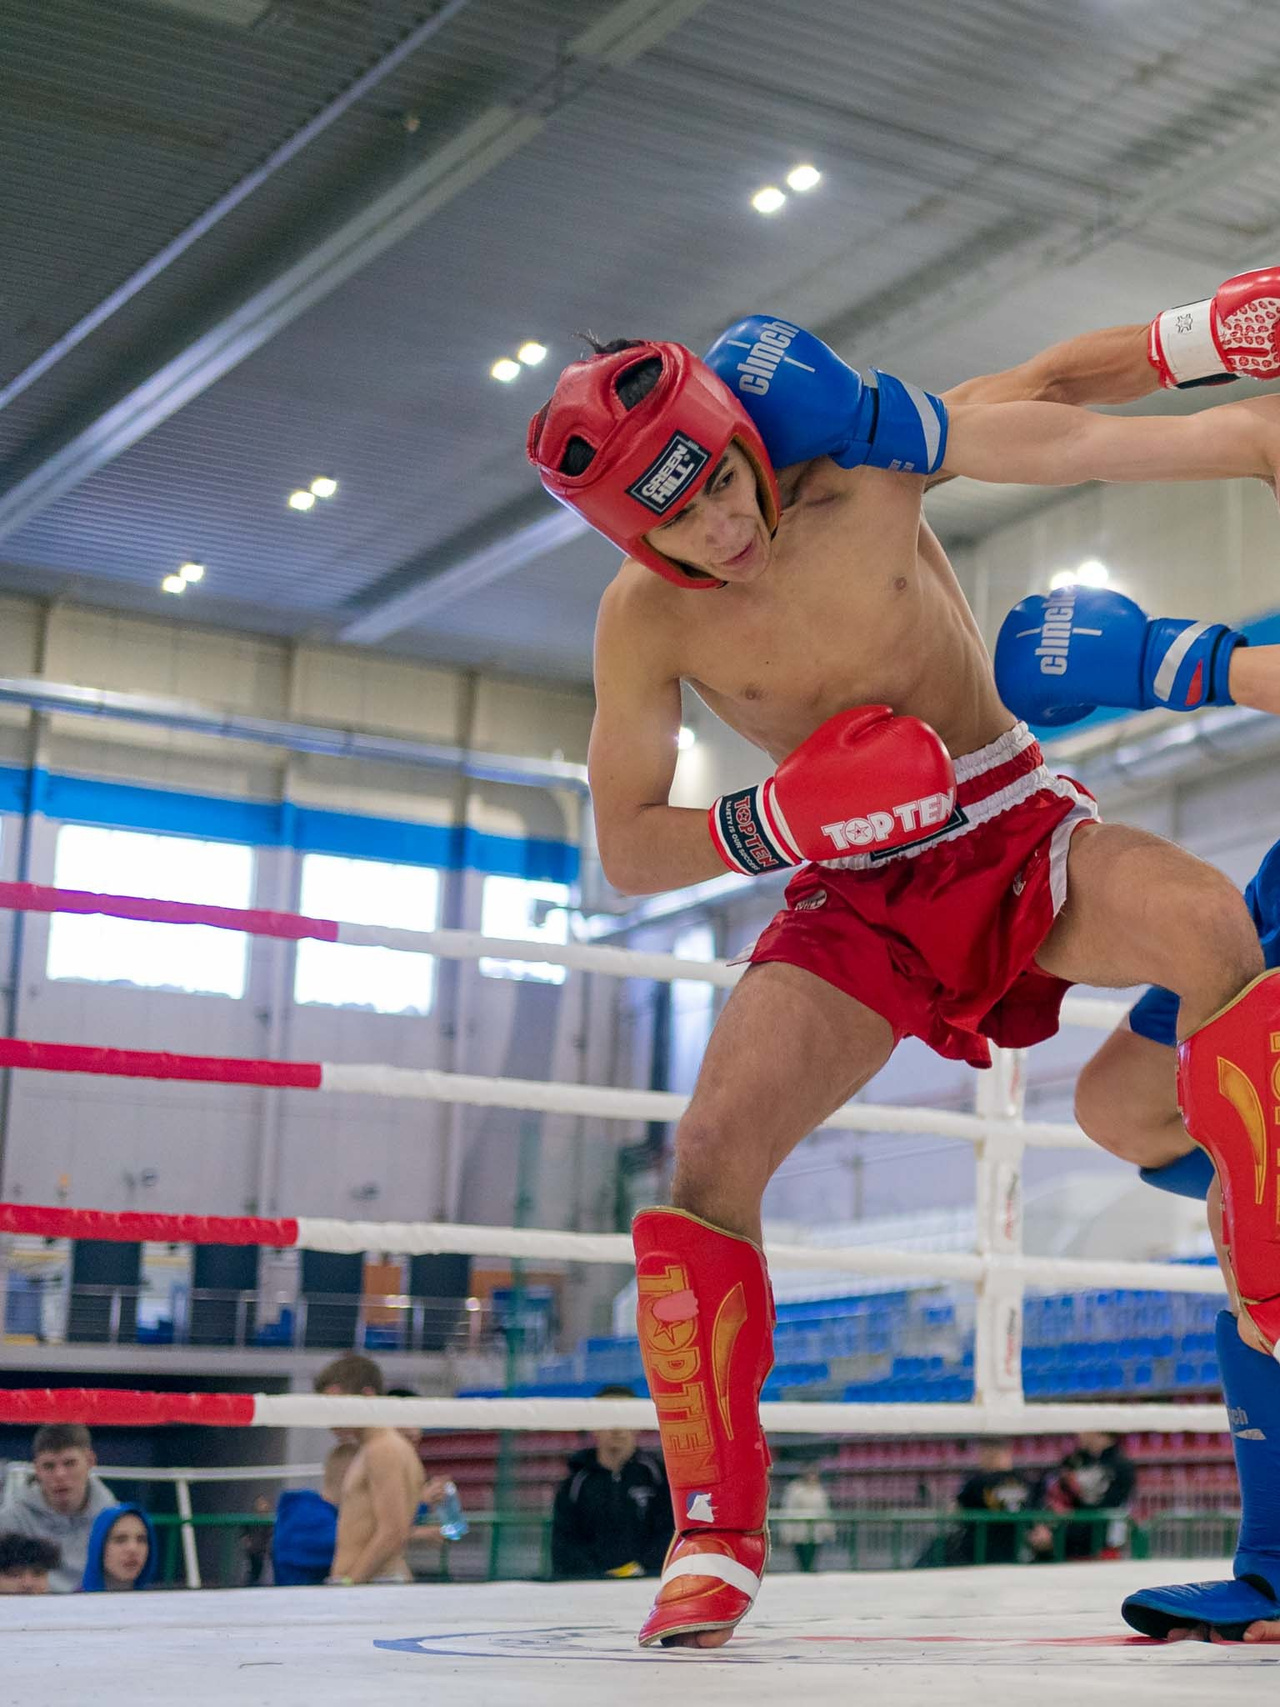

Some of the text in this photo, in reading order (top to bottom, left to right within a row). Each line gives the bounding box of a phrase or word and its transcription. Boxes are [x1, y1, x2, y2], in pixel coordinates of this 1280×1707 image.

[737, 321, 800, 396] clinch
[641, 443, 689, 497] GREEN
[650, 462, 695, 504] HILL
[820, 811, 895, 850] TOP
